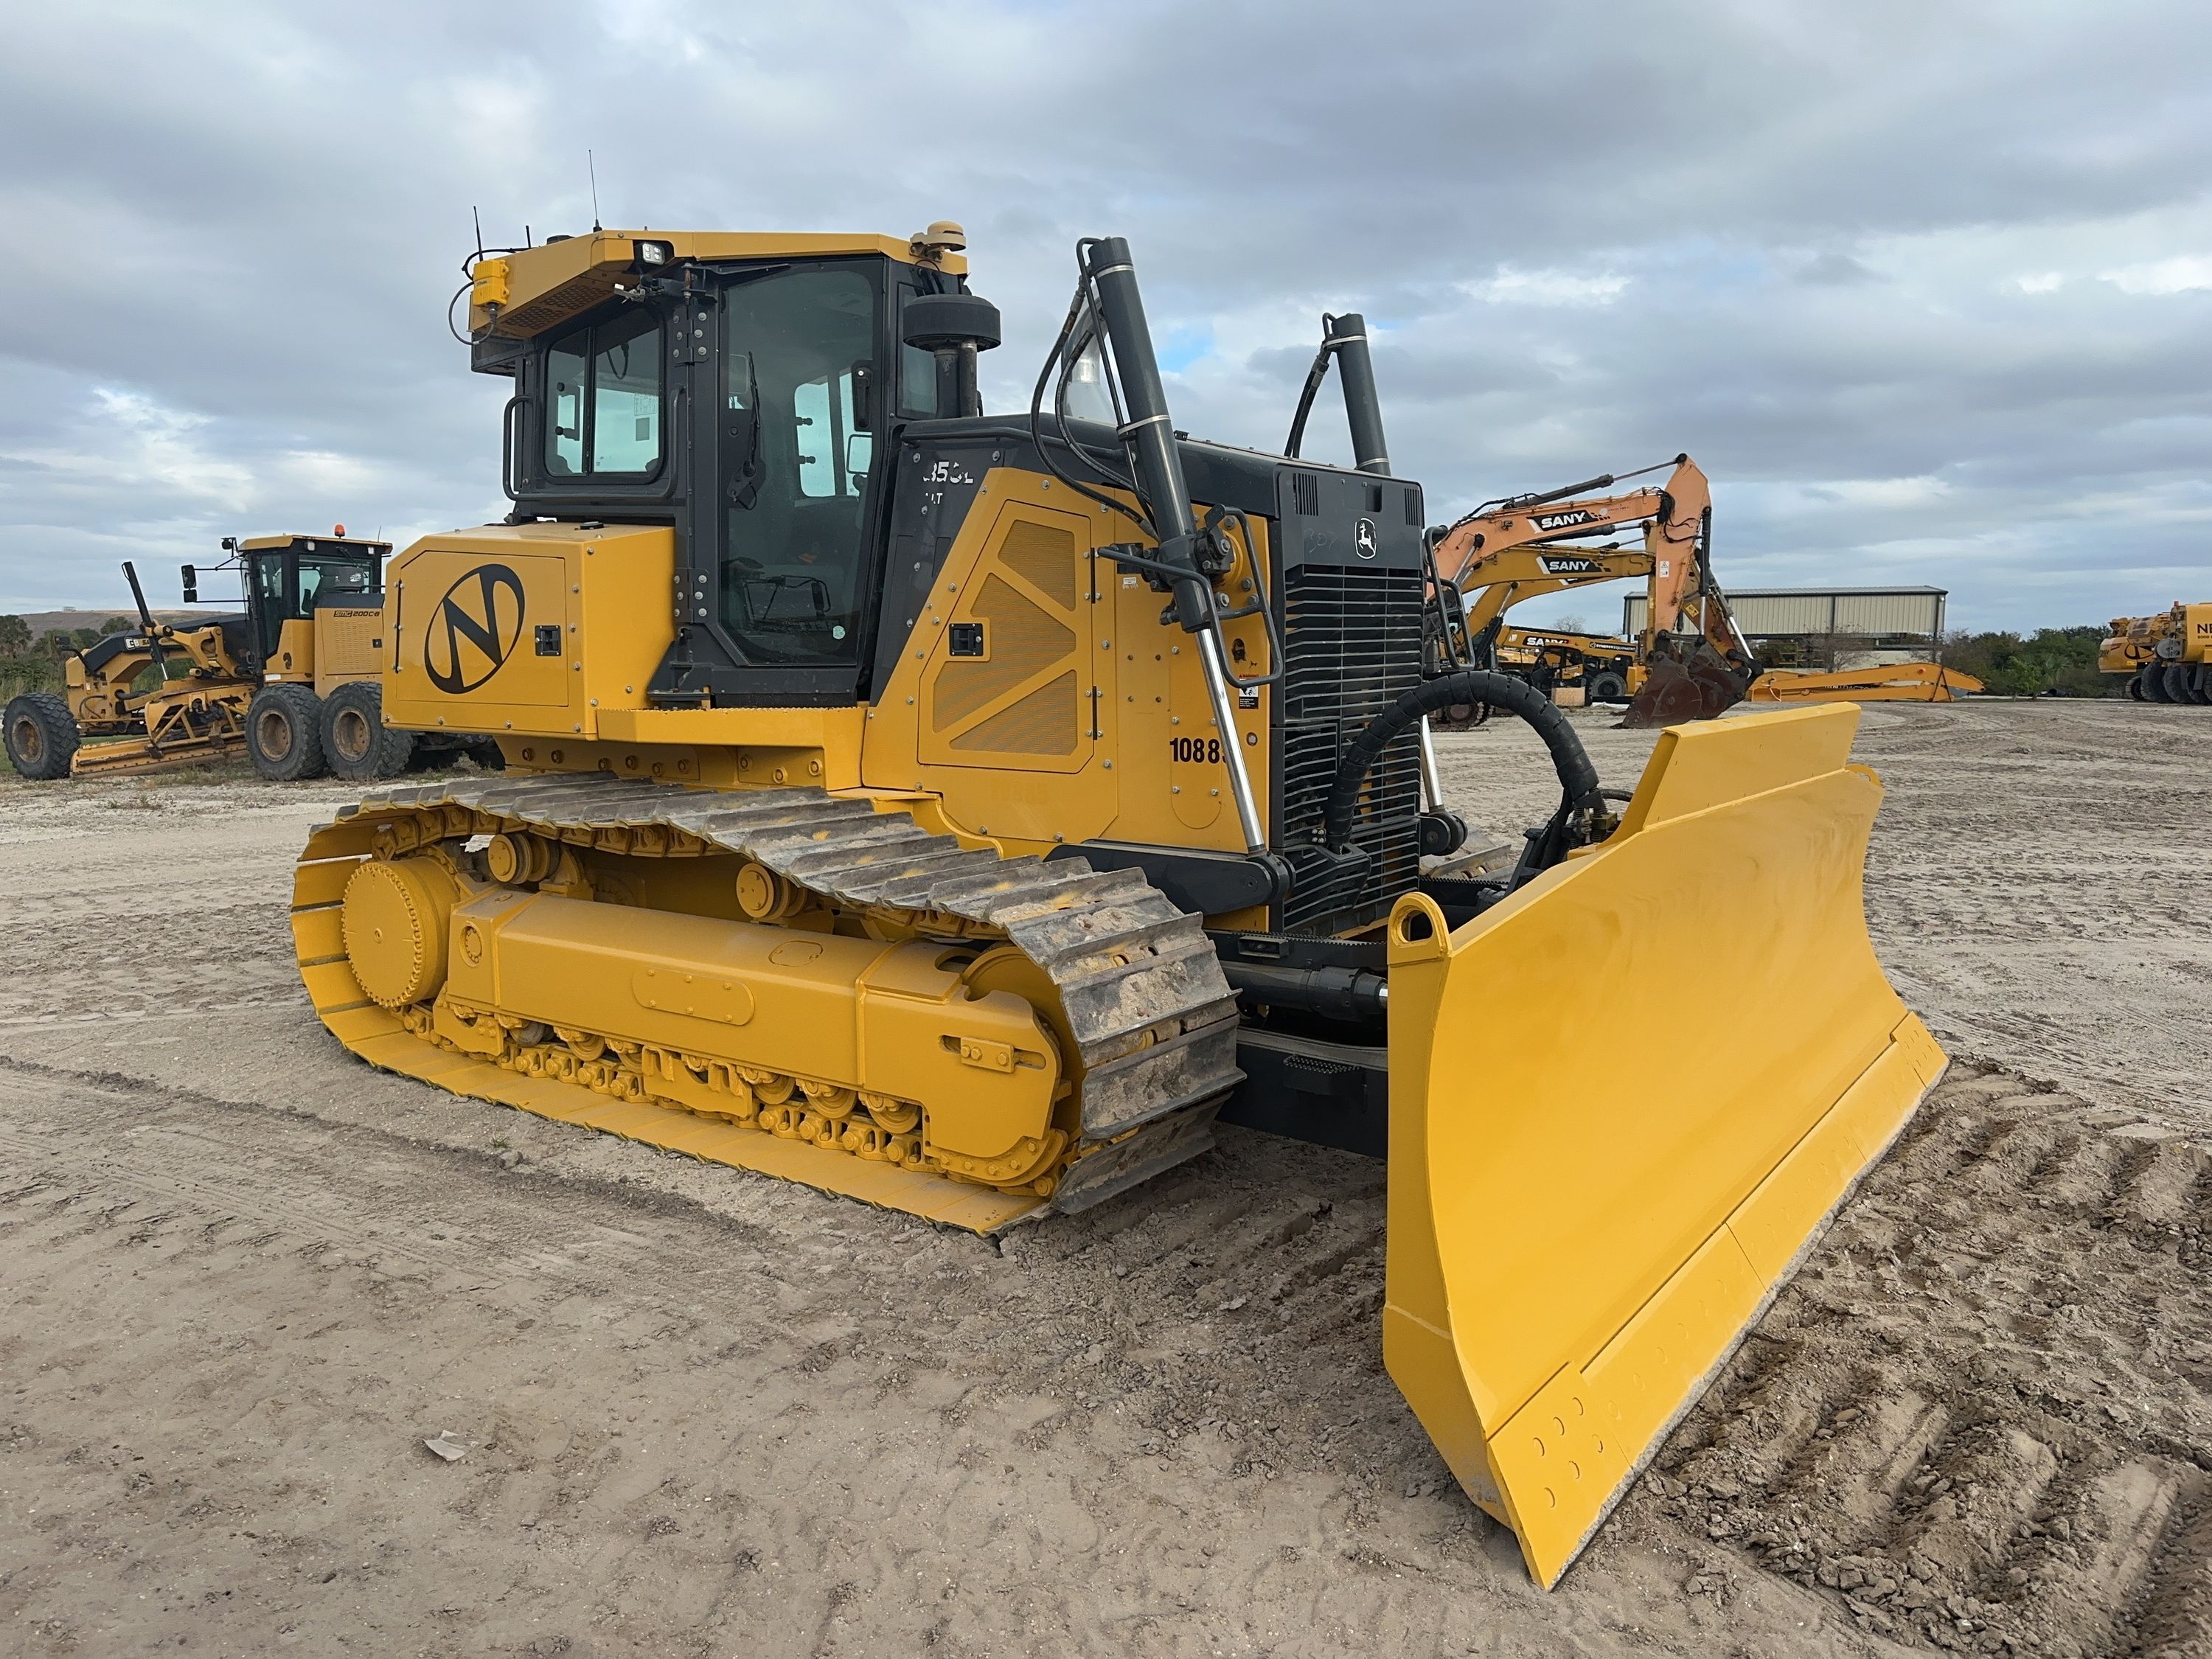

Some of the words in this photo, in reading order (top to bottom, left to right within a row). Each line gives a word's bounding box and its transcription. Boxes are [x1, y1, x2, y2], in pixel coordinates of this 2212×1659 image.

[1541, 512, 1586, 529] SANY
[1549, 561, 1590, 571] SANY
[1169, 737, 1226, 764] 1088
